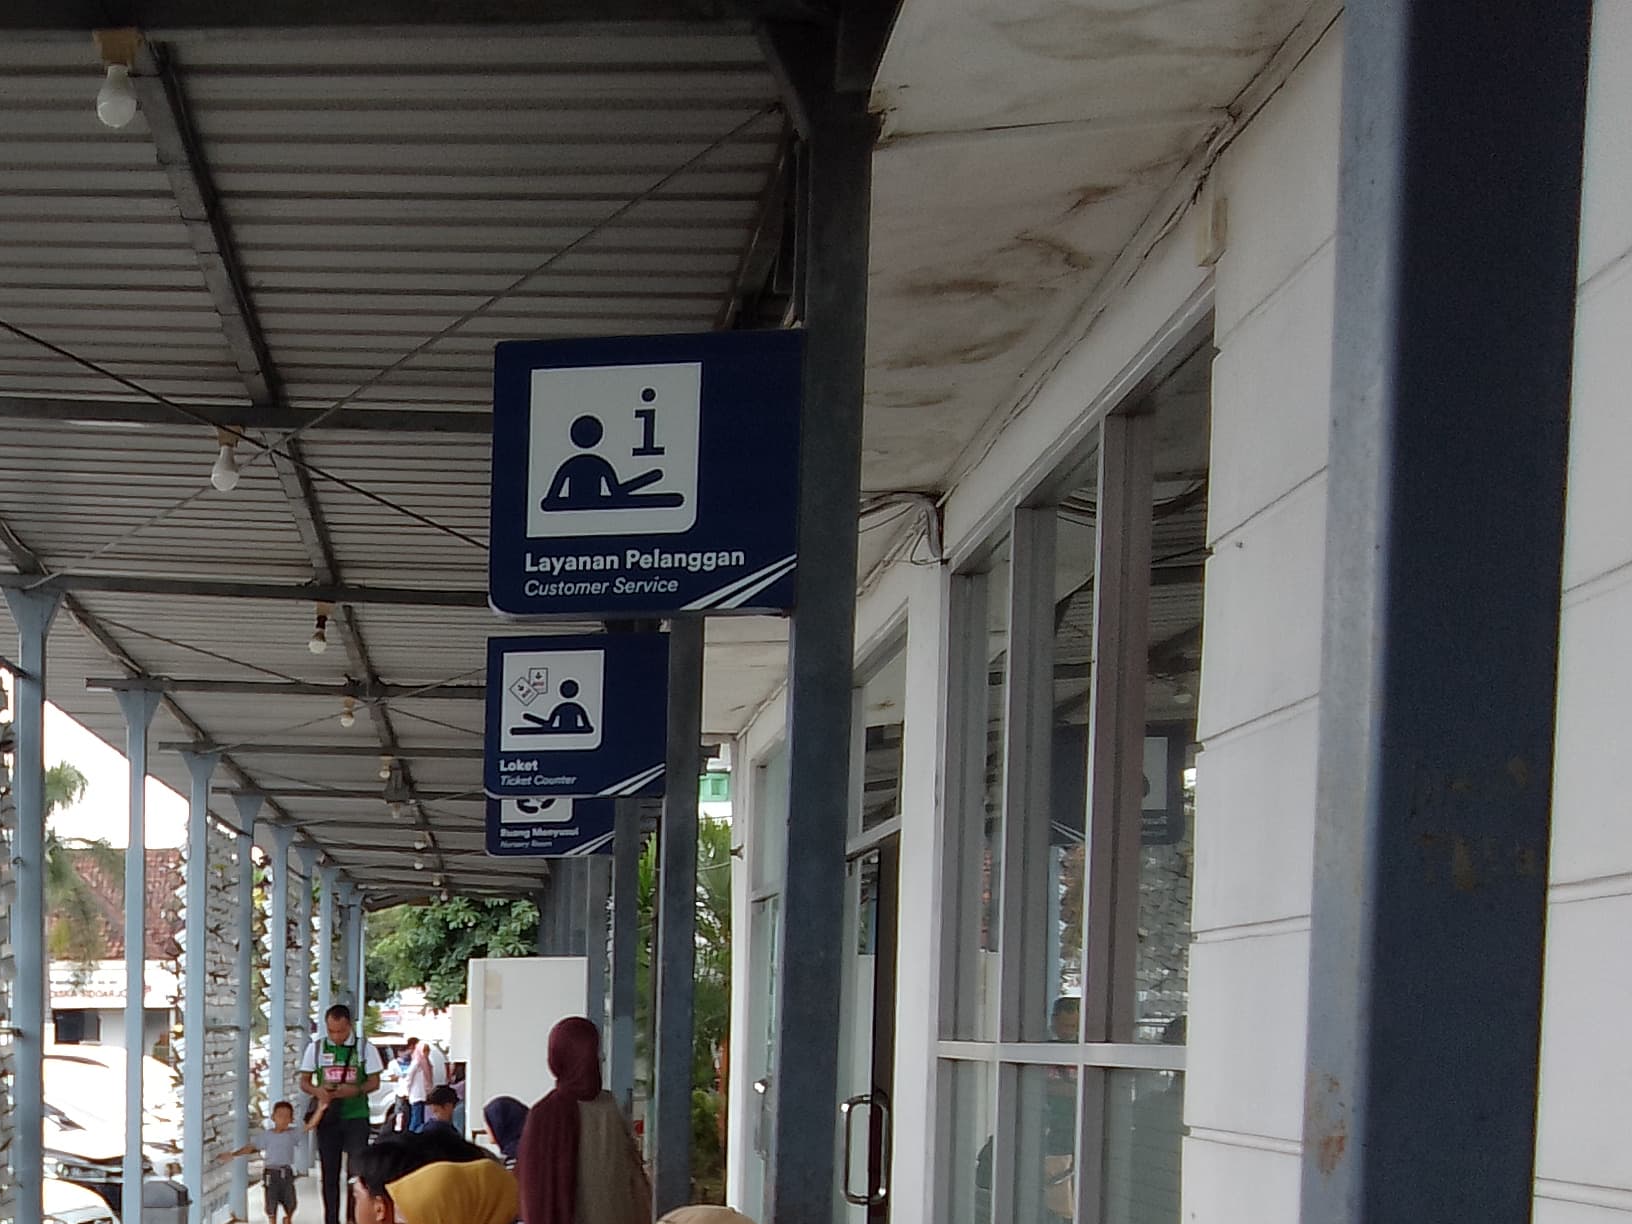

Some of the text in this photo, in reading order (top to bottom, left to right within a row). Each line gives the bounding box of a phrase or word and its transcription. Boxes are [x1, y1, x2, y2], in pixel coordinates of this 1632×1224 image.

[524, 548, 745, 576] Layanan Pelanggan
[524, 576, 679, 596] Customer Service
[499, 759, 539, 772] Loket
[500, 774, 577, 786] Ticket Counter
